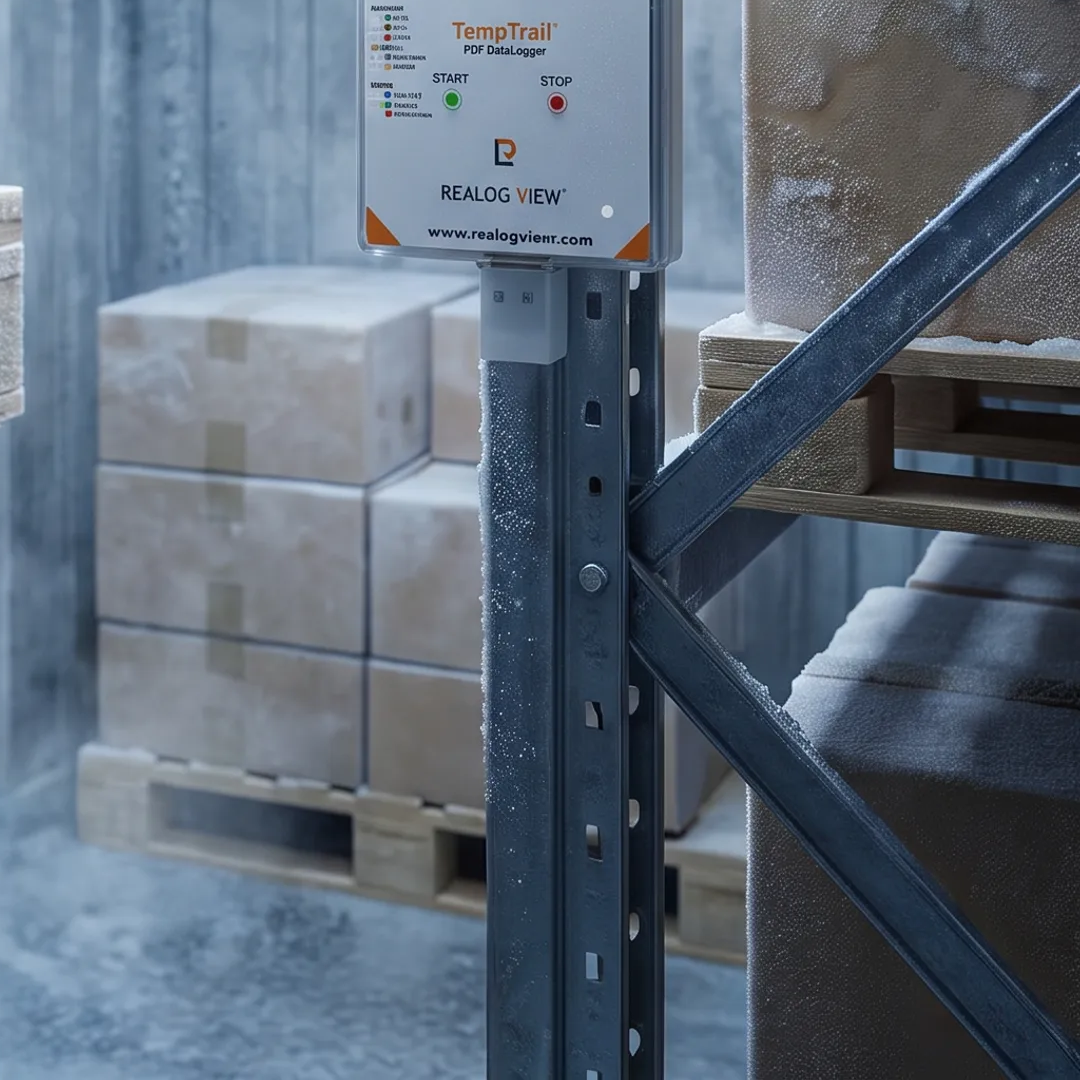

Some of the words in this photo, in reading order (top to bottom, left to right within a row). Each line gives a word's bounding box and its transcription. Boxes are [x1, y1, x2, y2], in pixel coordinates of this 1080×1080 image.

[452, 21, 552, 44] TempTrail
[463, 44, 485, 55] PDF
[487, 45, 547, 59] DataLogger
[432, 73, 470, 84] START
[540, 75, 573, 87] STOP
[441, 184, 510, 204] REALOG
